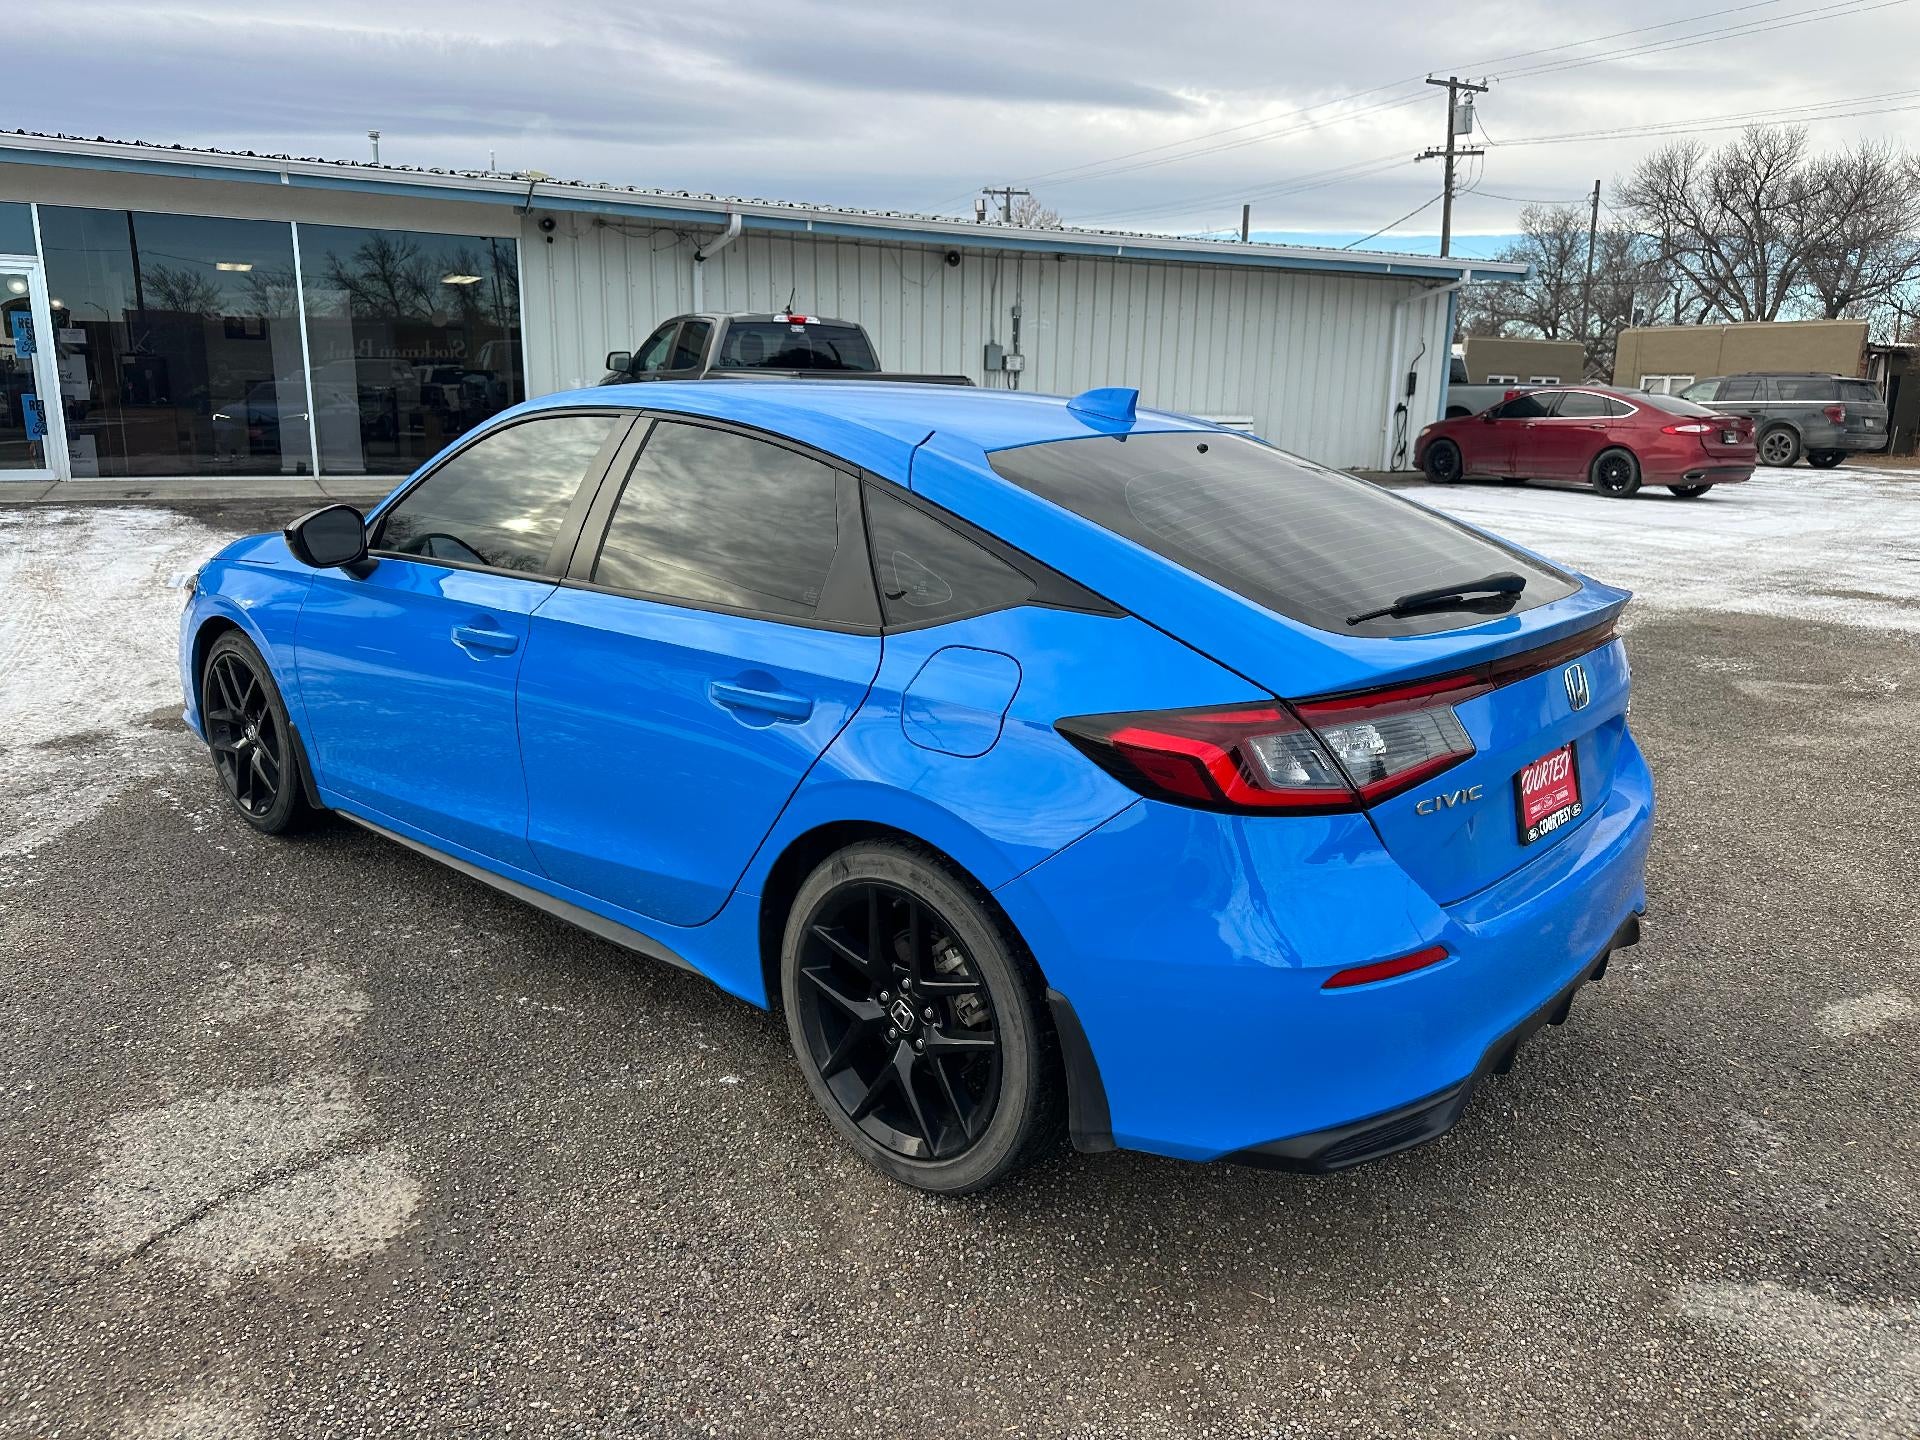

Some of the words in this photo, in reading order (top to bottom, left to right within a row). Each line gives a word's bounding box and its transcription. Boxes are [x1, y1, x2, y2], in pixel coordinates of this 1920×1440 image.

[1521, 750, 1572, 796] COURTESY
[1416, 784, 1483, 815] CIVIC
[1539, 805, 1571, 836] COURTESY
